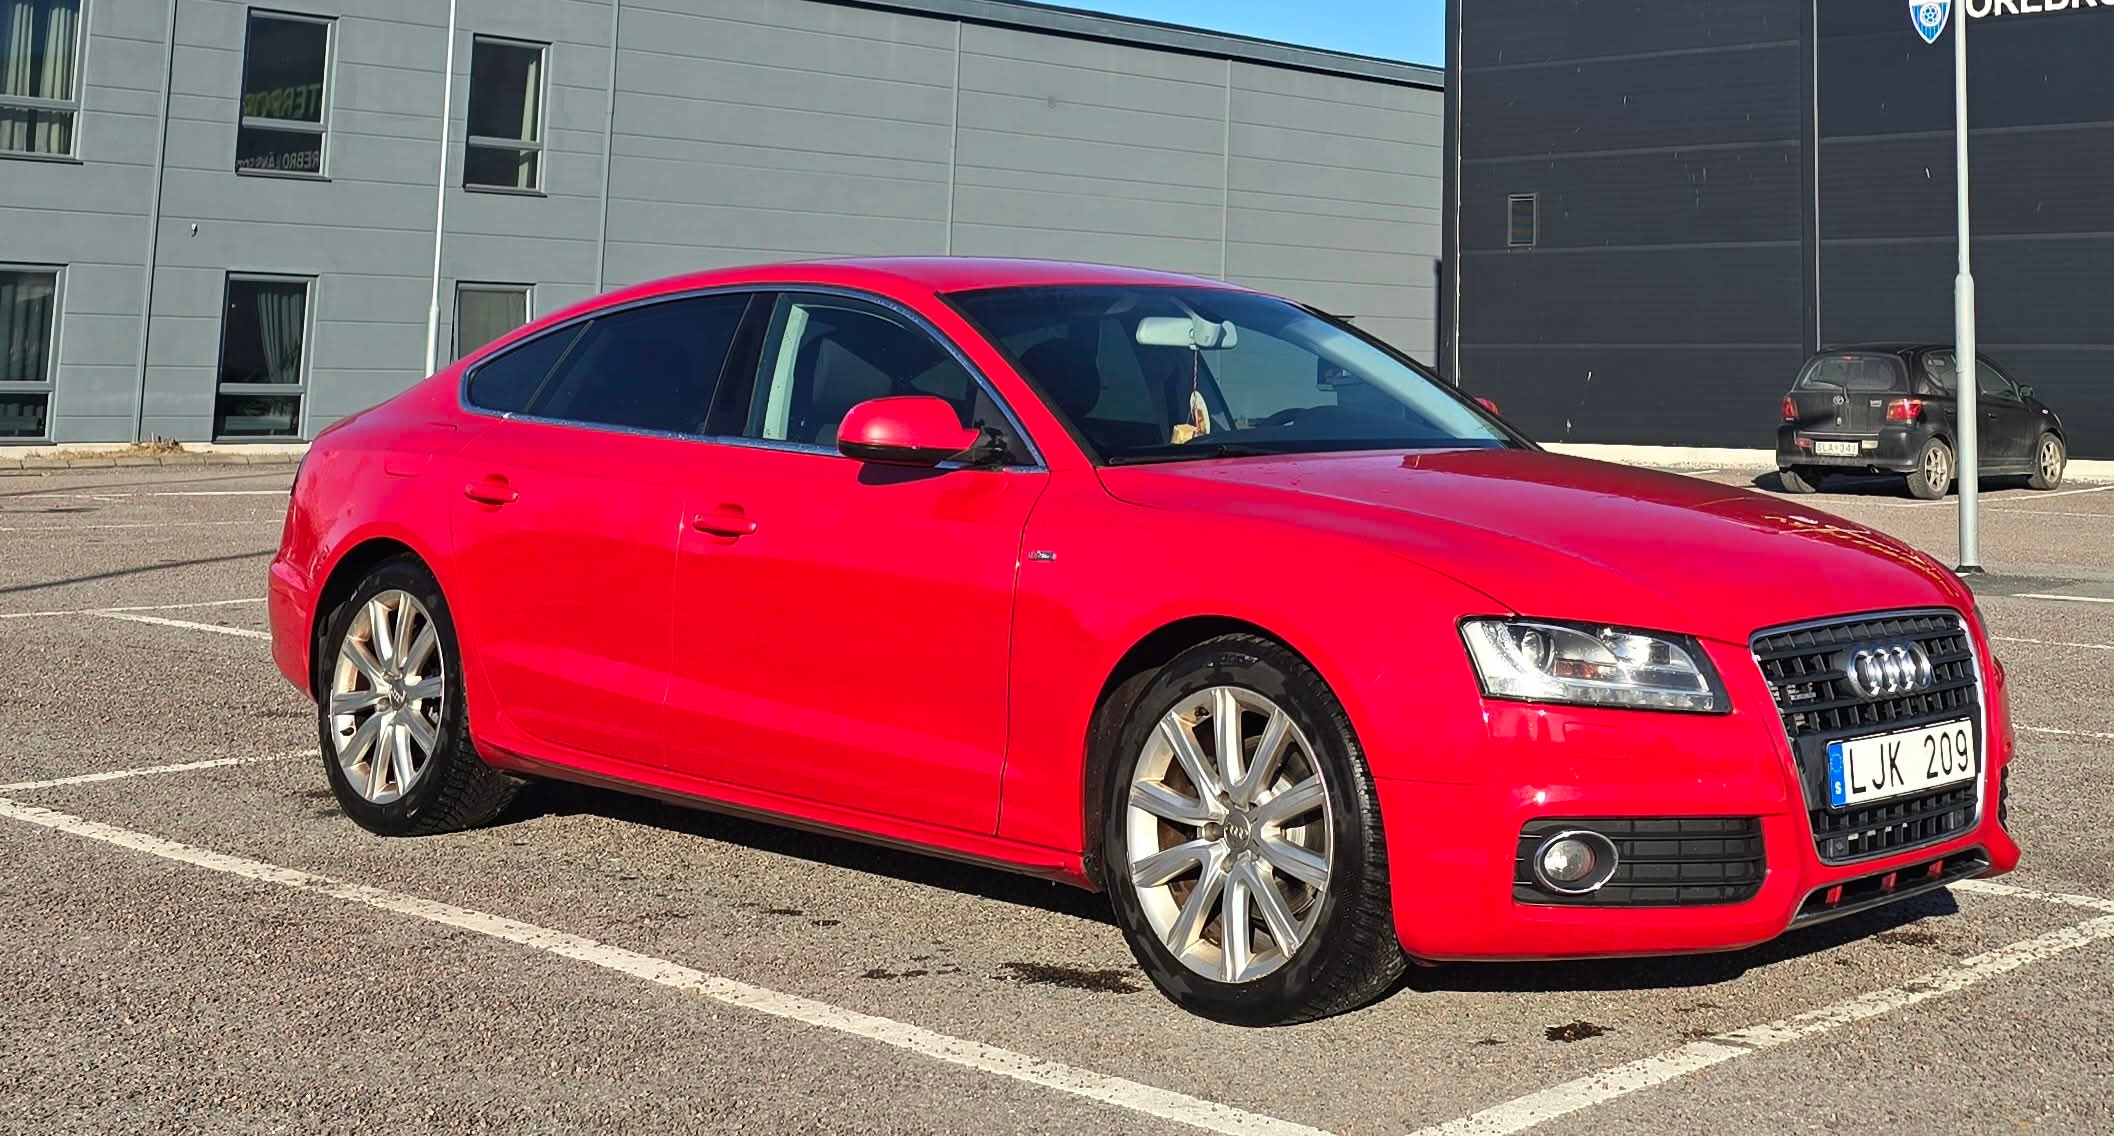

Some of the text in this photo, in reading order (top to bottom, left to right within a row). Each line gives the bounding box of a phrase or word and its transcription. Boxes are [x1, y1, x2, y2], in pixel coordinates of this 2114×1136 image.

[1849, 729, 1968, 795] LJK 209
[1834, 781, 1842, 795] S
